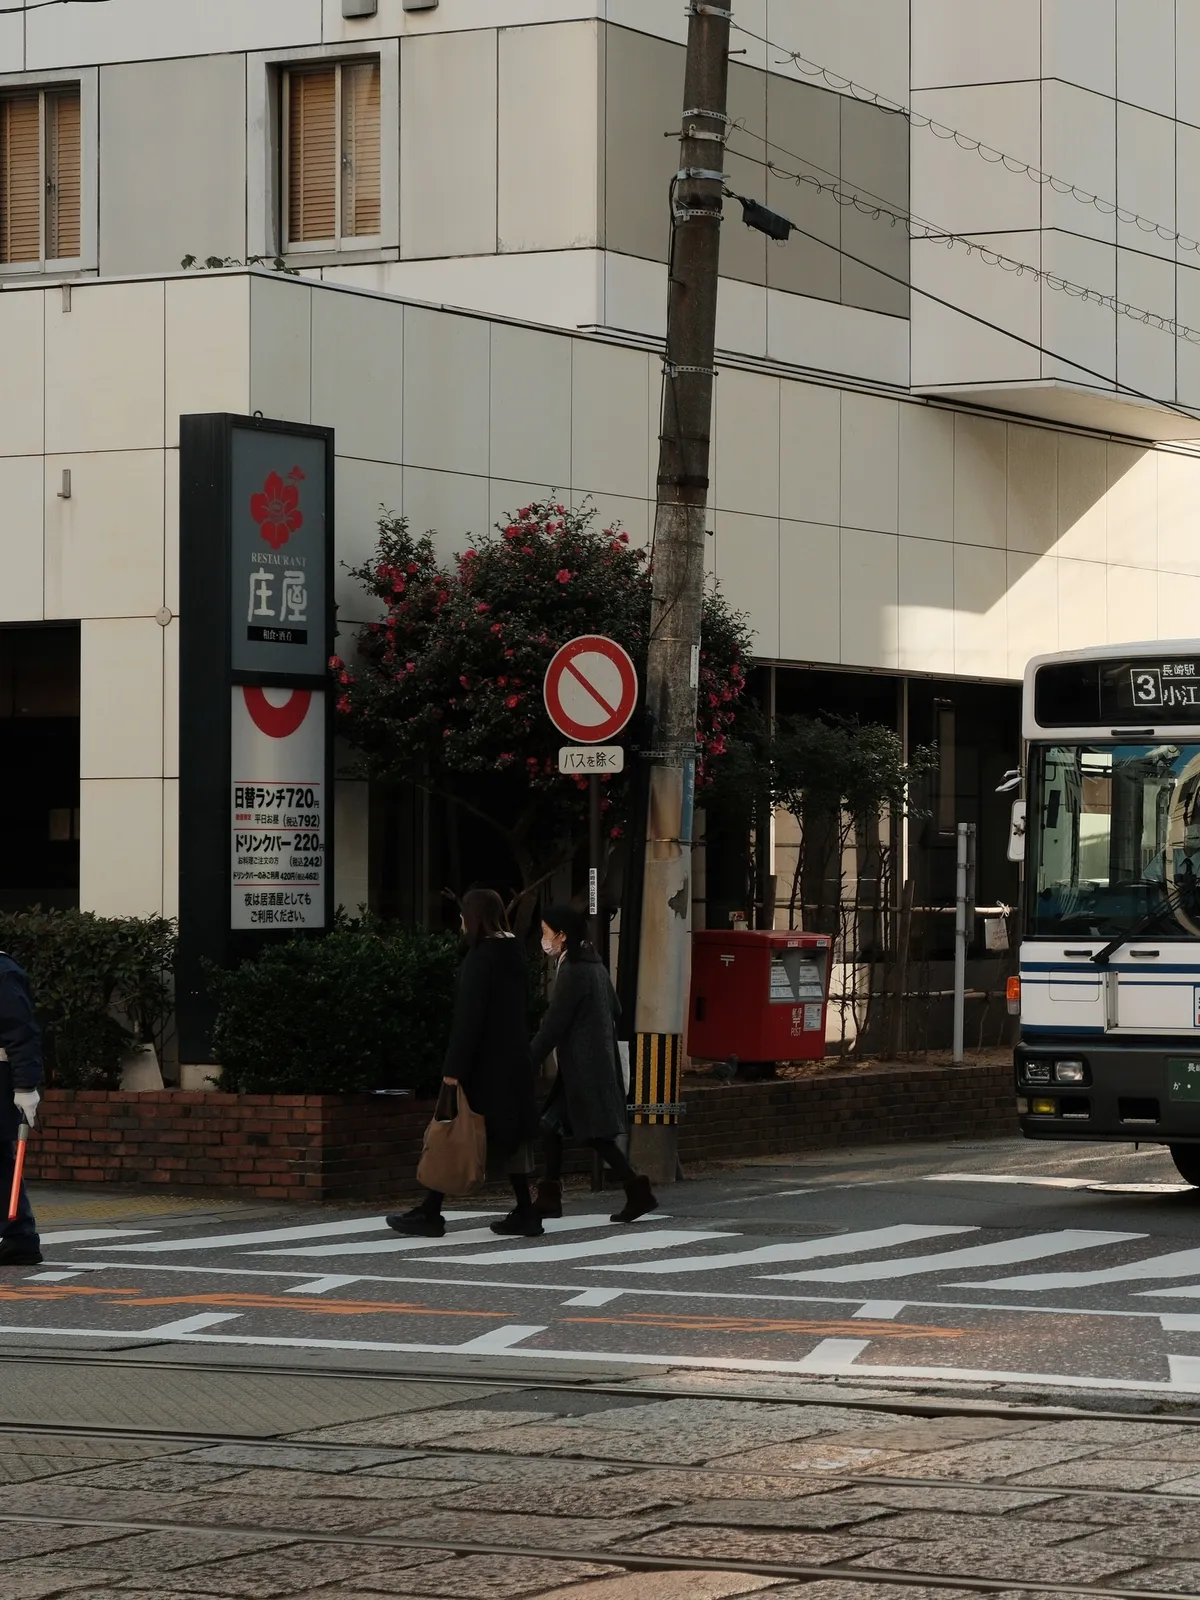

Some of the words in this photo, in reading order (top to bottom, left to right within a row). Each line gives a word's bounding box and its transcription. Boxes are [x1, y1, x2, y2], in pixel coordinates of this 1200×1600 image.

[252, 552, 307, 567] RESTAURANT
[248, 567, 308, 622] 庄屋
[1162, 664, 1196, 676] 長崎駅
[1136, 674, 1156, 700] 3
[564, 752, 616, 768] バスを除く
[254, 814, 279, 824] 平日お昼
[236, 834, 291, 852] ドリンクバー
[294, 833, 324, 851] 220円
[238, 857, 279, 865] お料理ご注文の方
[233, 872, 279, 880] ドリンクバーのみご利用
[244, 893, 312, 906] 夜は居酒屋としても
[250, 910, 305, 923] ご利用ください。
